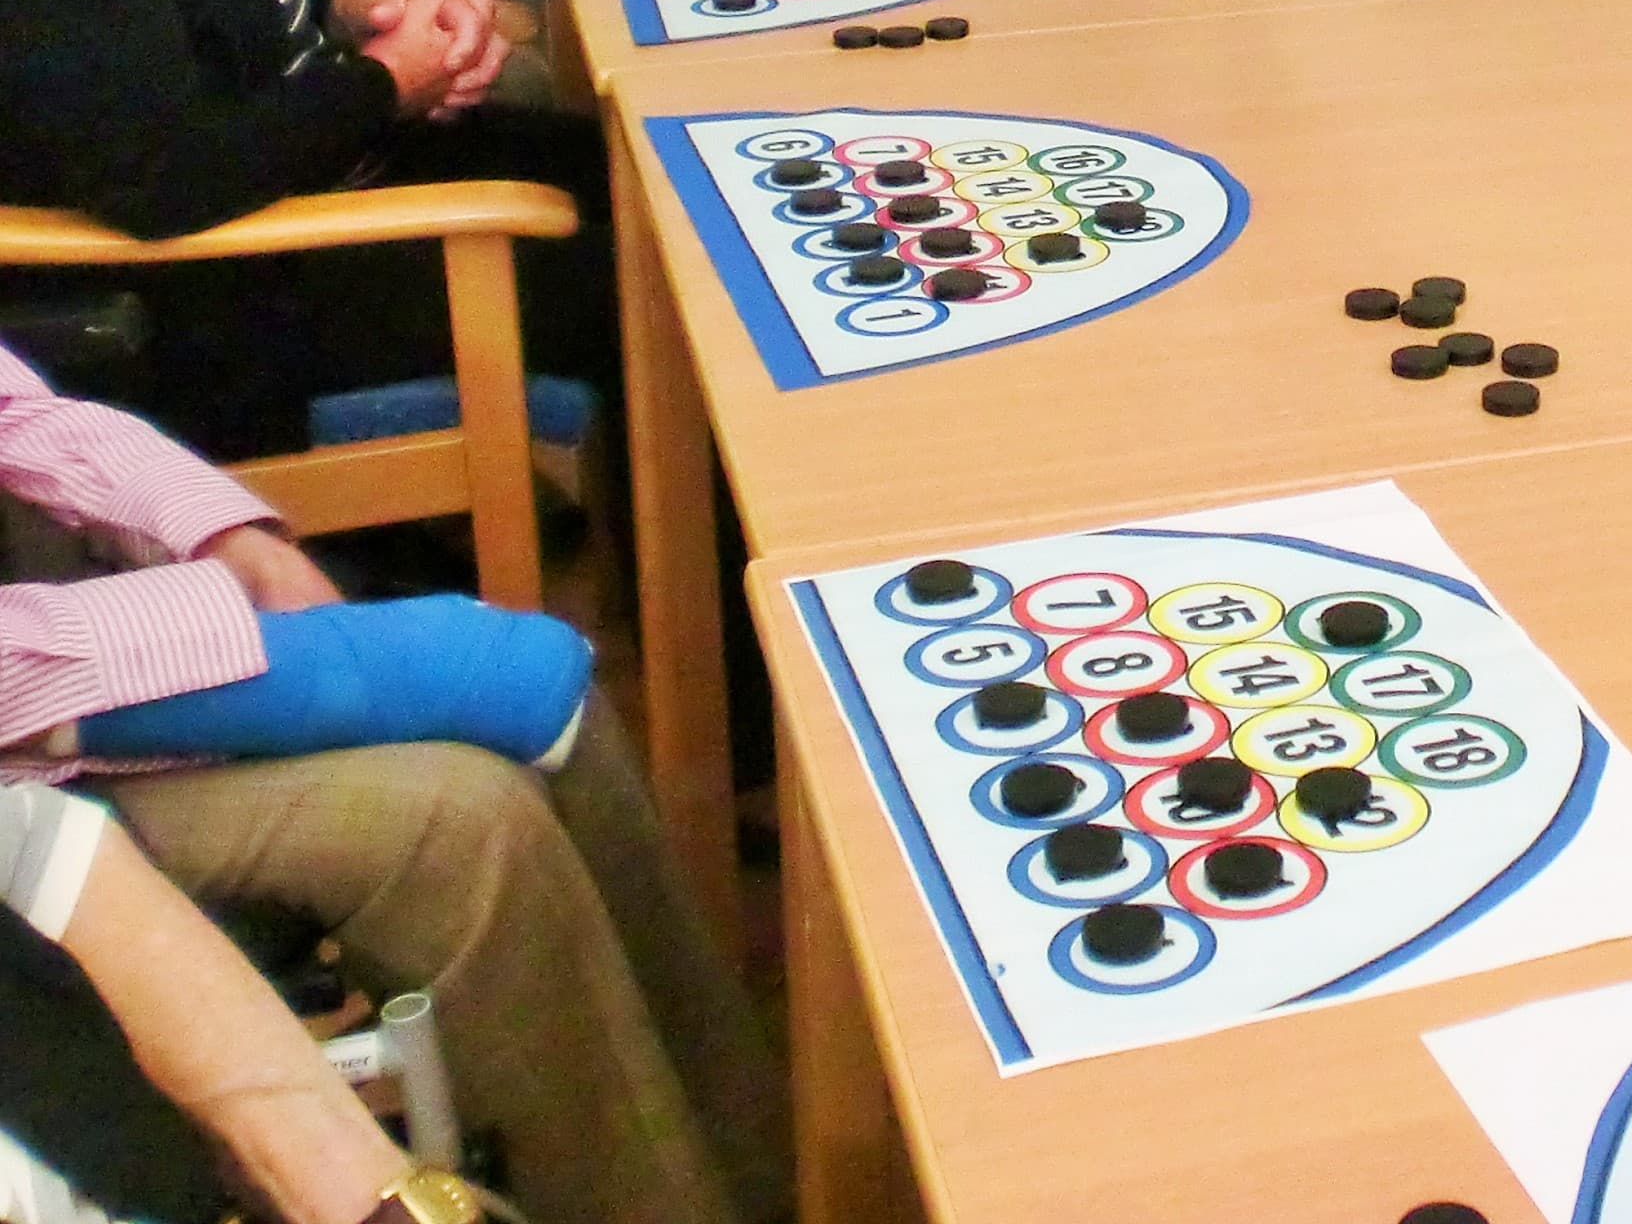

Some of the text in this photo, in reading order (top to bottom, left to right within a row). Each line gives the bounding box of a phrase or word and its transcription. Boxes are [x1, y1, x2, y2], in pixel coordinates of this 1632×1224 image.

[761, 140, 812, 153] 6
[858, 144, 908, 156] 7
[953, 145, 1009, 165] 15
[1051, 150, 1106, 170] 16
[976, 176, 1033, 199] 14
[1077, 180, 1135, 200] 17
[1002, 208, 1060, 230] 13
[864, 308, 923, 322] 1
[1046, 588, 1117, 611] 7
[1179, 594, 1258, 631] 15
[942, 641, 1015, 667] 5
[1082, 651, 1153, 678] 8
[1219, 655, 1300, 697] 14
[1361, 663, 1446, 700] 17
[1264, 717, 1348, 762] 13
[1412, 727, 1497, 773] 18
